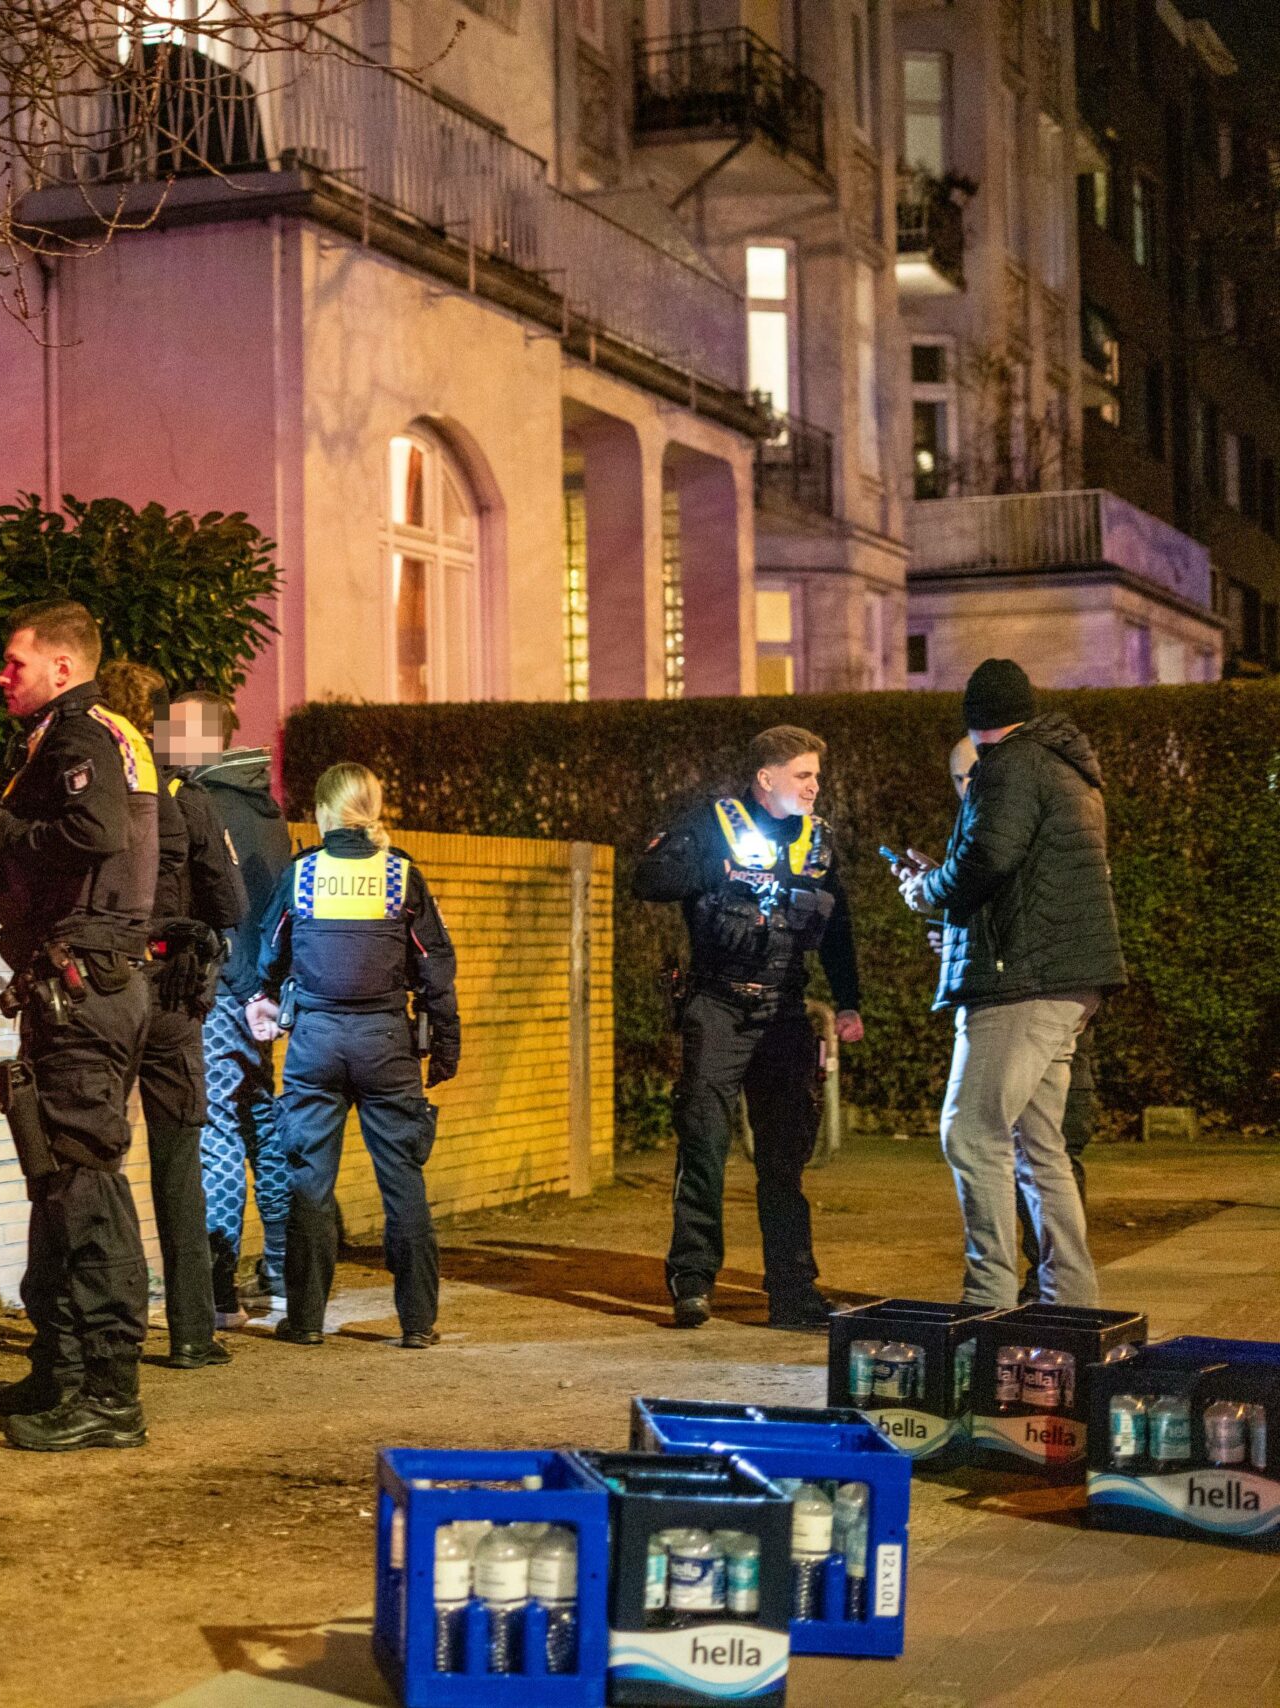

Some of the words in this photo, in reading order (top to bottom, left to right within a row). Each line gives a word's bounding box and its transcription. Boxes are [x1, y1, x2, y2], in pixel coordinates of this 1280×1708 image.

[317, 876, 383, 896] POLIZEI
[879, 1415, 927, 1439] hella
[1026, 1422, 1076, 1446] hella
[1188, 1477, 1260, 1511] hella
[691, 1637, 762, 1666] hella
